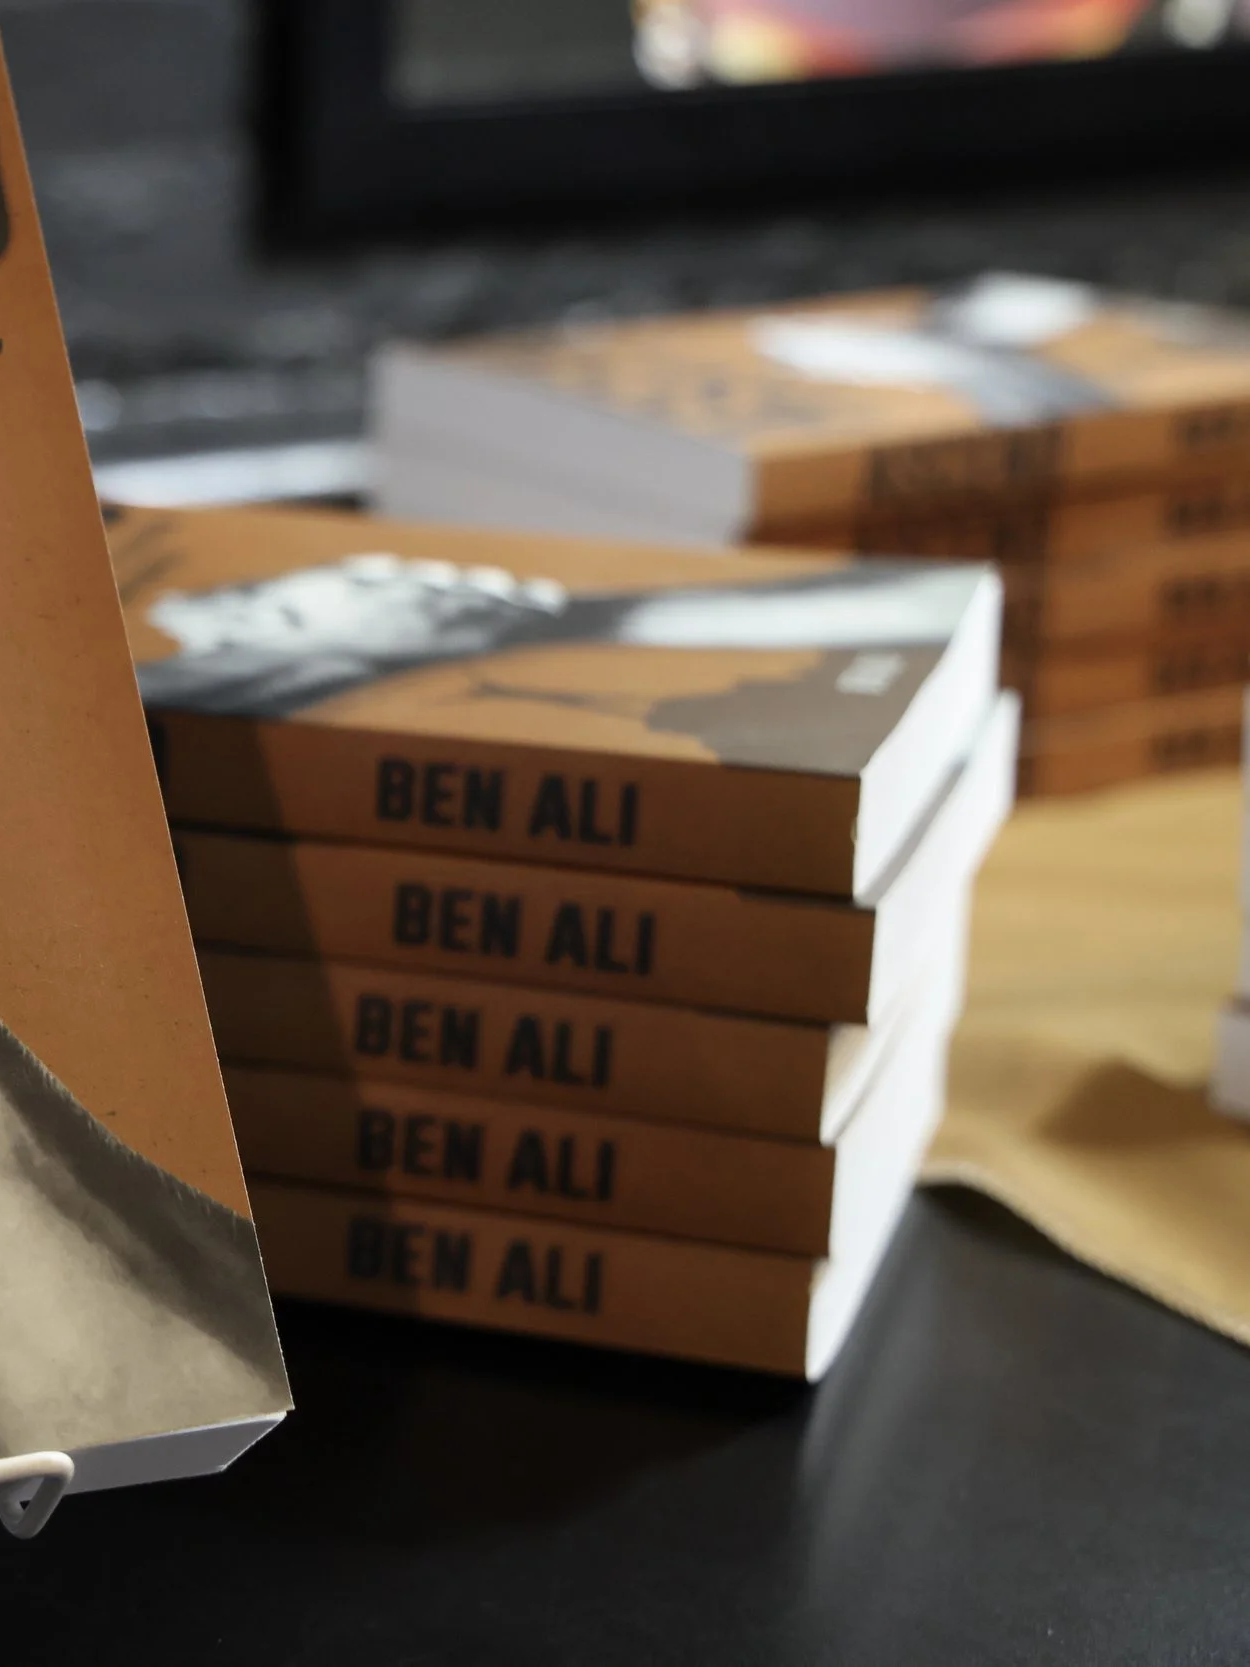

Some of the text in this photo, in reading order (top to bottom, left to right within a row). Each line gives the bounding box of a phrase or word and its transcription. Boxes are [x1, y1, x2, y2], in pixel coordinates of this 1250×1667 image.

[376, 757, 640, 847] BEN ALI
[393, 882, 656, 976] BEN ALI
[355, 995, 613, 1089] BEN ALI
[357, 1110, 615, 1202] BEN ALI
[348, 1218, 603, 1316] BEN ALI
